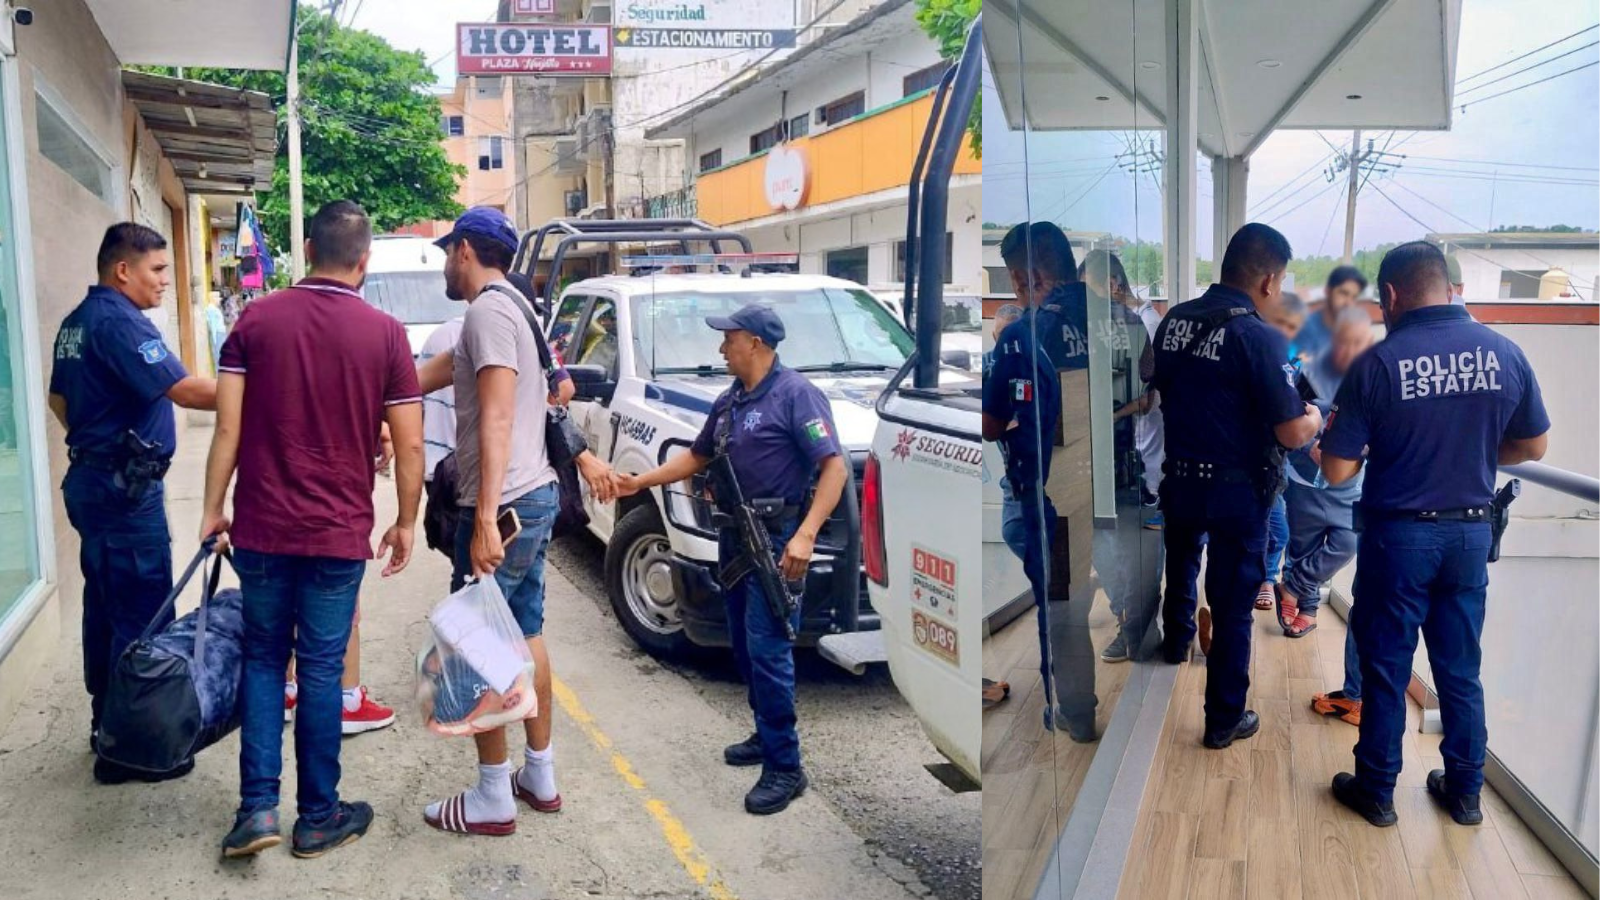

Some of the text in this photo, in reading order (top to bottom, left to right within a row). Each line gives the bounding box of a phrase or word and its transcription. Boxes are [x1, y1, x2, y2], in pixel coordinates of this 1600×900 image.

[628, 4, 706, 23] Seguridad
[469, 28, 601, 55] HOTEL
[632, 30, 774, 47] ESTACIONAMIENTO
[482, 58, 519, 69] PLAZA
[1162, 334, 1221, 361] ESTTAL
[1398, 346, 1502, 381] POLICÍA
[1401, 370, 1502, 401] ESTATAL
[916, 435, 983, 466] SEGURID
[914, 551, 953, 583] 911
[929, 621, 956, 652] 089
